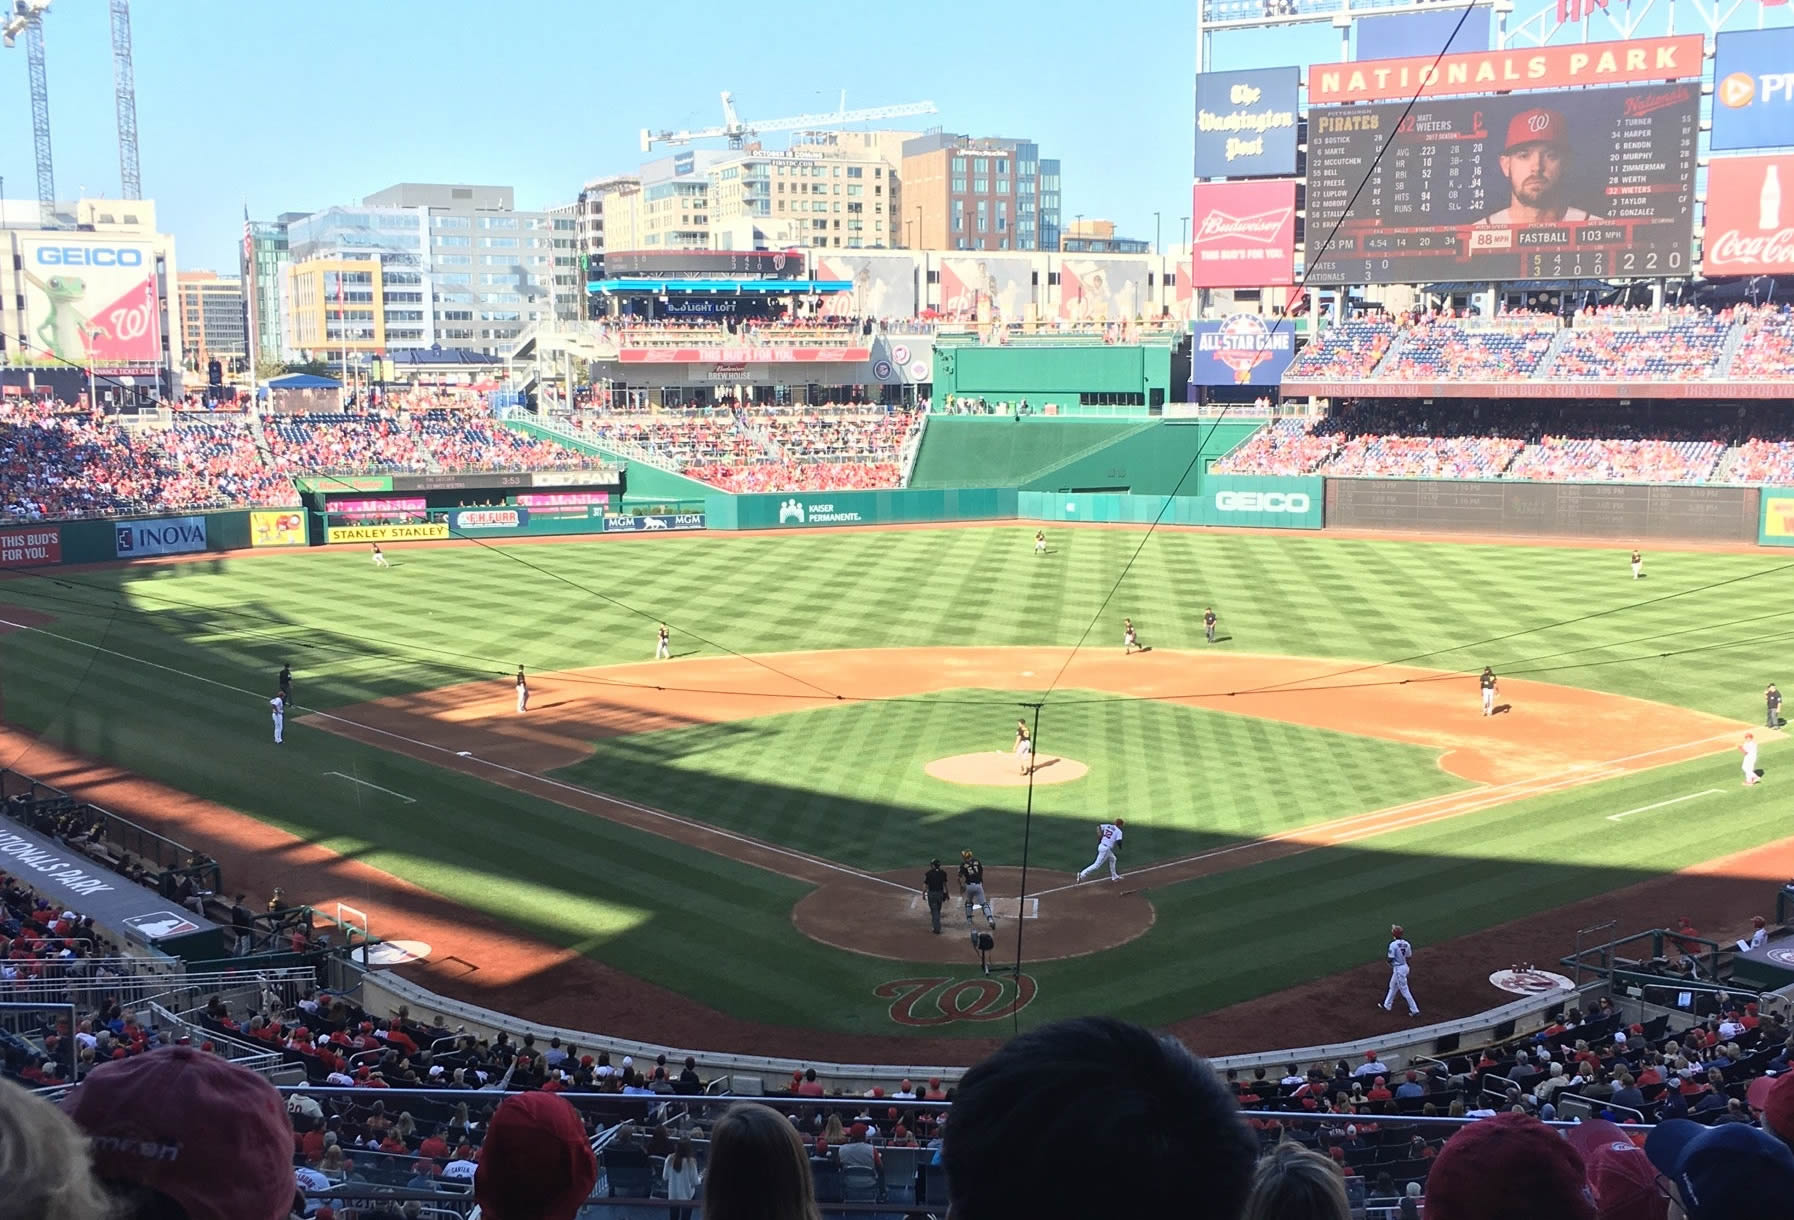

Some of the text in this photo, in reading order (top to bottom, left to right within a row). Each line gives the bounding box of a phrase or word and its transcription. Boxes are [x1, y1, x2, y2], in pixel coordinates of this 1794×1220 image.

[1320, 45, 1680, 94] NATIONALS PARK
[1230, 83, 1261, 106] The
[1197, 108, 1294, 133] Washington
[1416, 113, 1433, 122] MATT
[1624, 117, 1652, 126] TURNER
[1318, 114, 1379, 133] PIRATES
[1415, 121, 1452, 132] WIETERS
[1623, 129, 1652, 139] HARPER
[1225, 135, 1264, 162] Post
[1472, 143, 1483, 153] 20
[1609, 151, 1653, 162] 20 MURPHY
[1395, 157, 1432, 168] HR 10
[1610, 165, 1619, 173] 11
[1622, 163, 1666, 172] ZIMMERMAN
[1421, 169, 1432, 178] 52
[1621, 175, 1647, 184] WERTH
[1621, 185, 1652, 194] WIETERS
[1394, 193, 1410, 201] HITS
[1620, 197, 1647, 205] TAYLOR
[1394, 203, 1430, 213] RUNS 43
[1619, 208, 1655, 217] GONZALEZ
[1202, 216, 1282, 235] Budweiser
[1444, 236, 1456, 245] 34
[1477, 234, 1493, 246] 88
[1519, 229, 1568, 245] FASTBALL
[1581, 230, 1622, 241] 103 MPH
[1338, 239, 1354, 249] PM
[1369, 239, 1388, 248] 4.54
[1396, 238, 1406, 247] 14
[1419, 237, 1431, 246] 20
[36, 246, 142, 267] GEICO
[1533, 252, 1603, 266] 5 4 1 2
[1623, 252, 1681, 270] 2 2 0
[1364, 259, 1372, 270] 5
[1381, 259, 1389, 270] 0
[1364, 271, 1372, 281] 3
[1533, 265, 1602, 277] 3 2 0 0
[687, 303, 713, 312] LIGHT
[715, 304, 737, 313] LOFT
[1255, 335, 1290, 350] GAME
[708, 371, 751, 380] BREW HOUSE
[1320, 386, 1342, 396] THIS
[1343, 386, 1374, 396] BUD'S
[1376, 386, 1396, 396] FOR
[1494, 385, 1517, 397] THIS
[1520, 385, 1553, 397] BUD'S
[1555, 385, 1576, 397] FOR
[1684, 385, 1709, 397] THIS
[1751, 385, 1774, 397] FOR
[502, 477, 521, 485] 3:53
[1215, 491, 1310, 513] GEICO
[609, 517, 635, 527] MGM
[675, 515, 701, 524] MGM
[139, 525, 205, 548] INOVA
[333, 526, 444, 539] STANLEY STANLEY
[1, 532, 59, 548] THIS BUD'S
[2, 547, 49, 561] FOR YOU.
[48, 869, 115, 896] PARK
